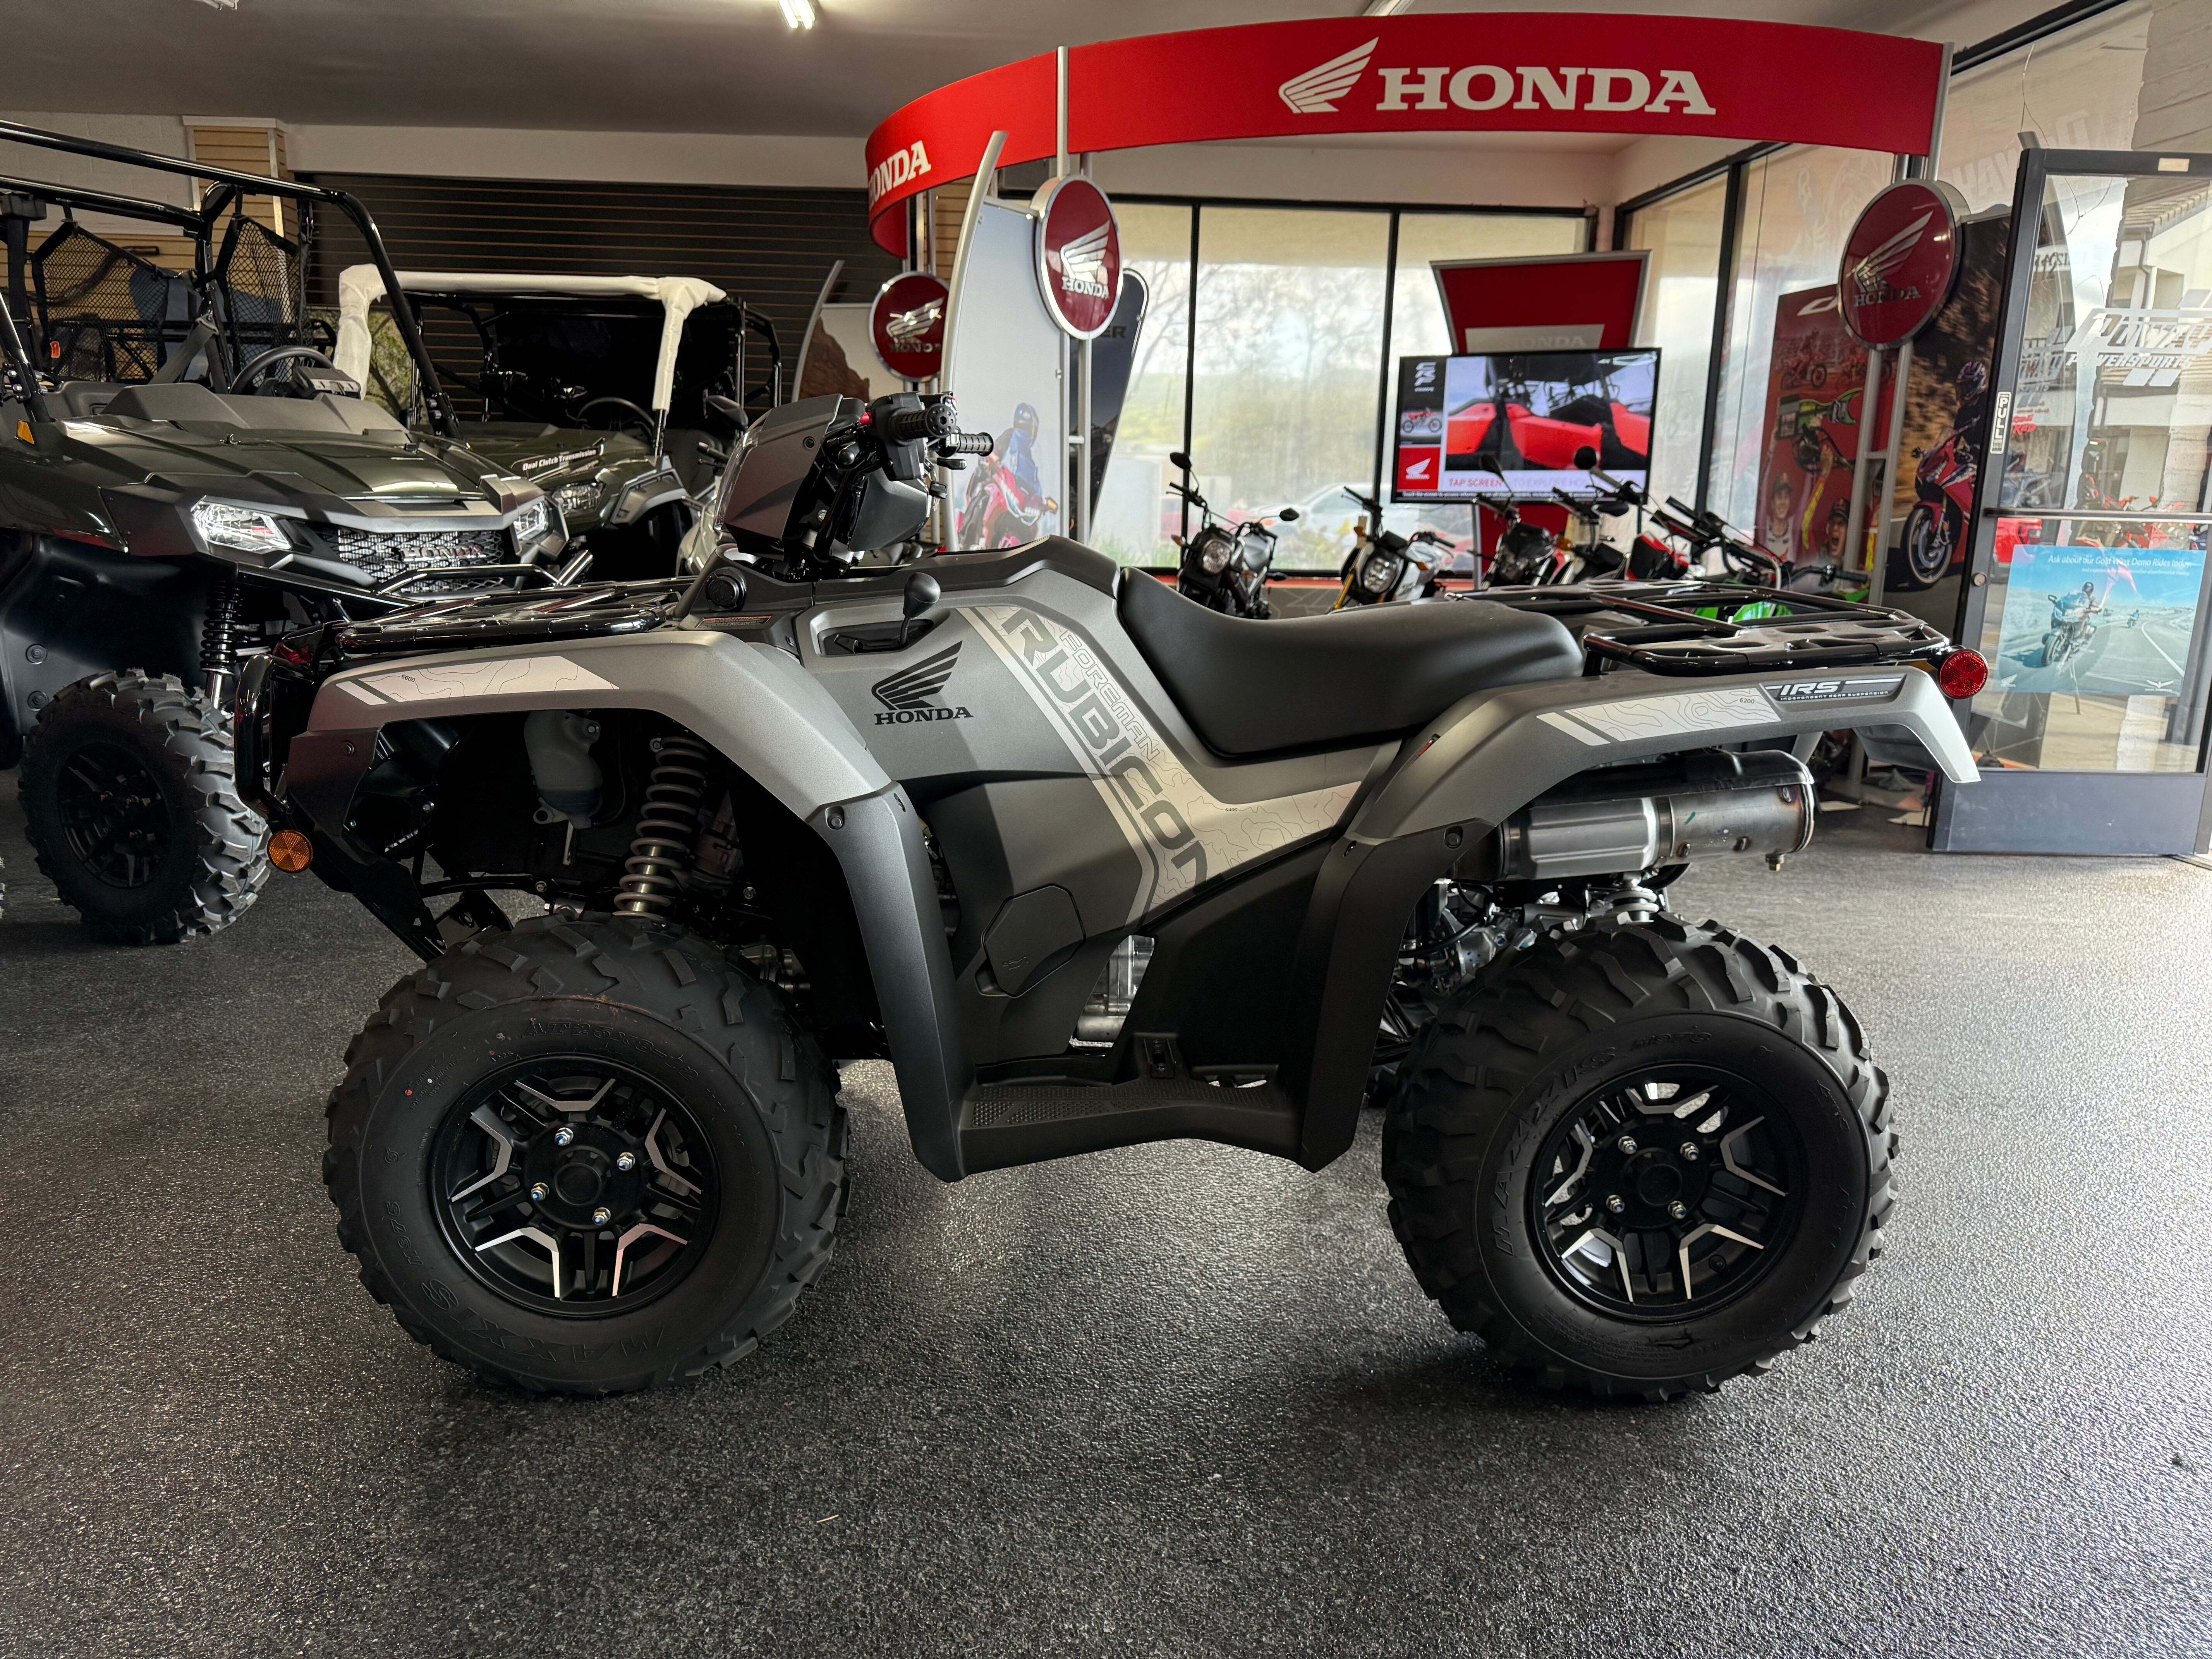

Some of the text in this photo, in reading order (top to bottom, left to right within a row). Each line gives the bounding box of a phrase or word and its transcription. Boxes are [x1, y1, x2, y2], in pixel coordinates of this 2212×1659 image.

[1376, 65, 1717, 115] HONDA
[1061, 276, 1109, 299] HONDA
[2066, 354, 2197, 368] PWERSPORTS
[1995, 397, 2008, 439] PULL
[523, 450, 596, 471] Dual Clutch Transmission
[1449, 477, 1465, 487] TAP
[2048, 555, 2060, 563] Ask
[2062, 556, 2082, 564] about
[2130, 558, 2150, 566] Demo
[2152, 558, 2169, 567] Rides
[401, 674, 416, 682] 6600
[1780, 681, 1842, 696] IRS
[1060, 628, 1163, 761] FOREMAN
[874, 706, 974, 725] HONDA
[1001, 607, 1208, 892] RUBICON
[386, 1201, 424, 1266] M975
